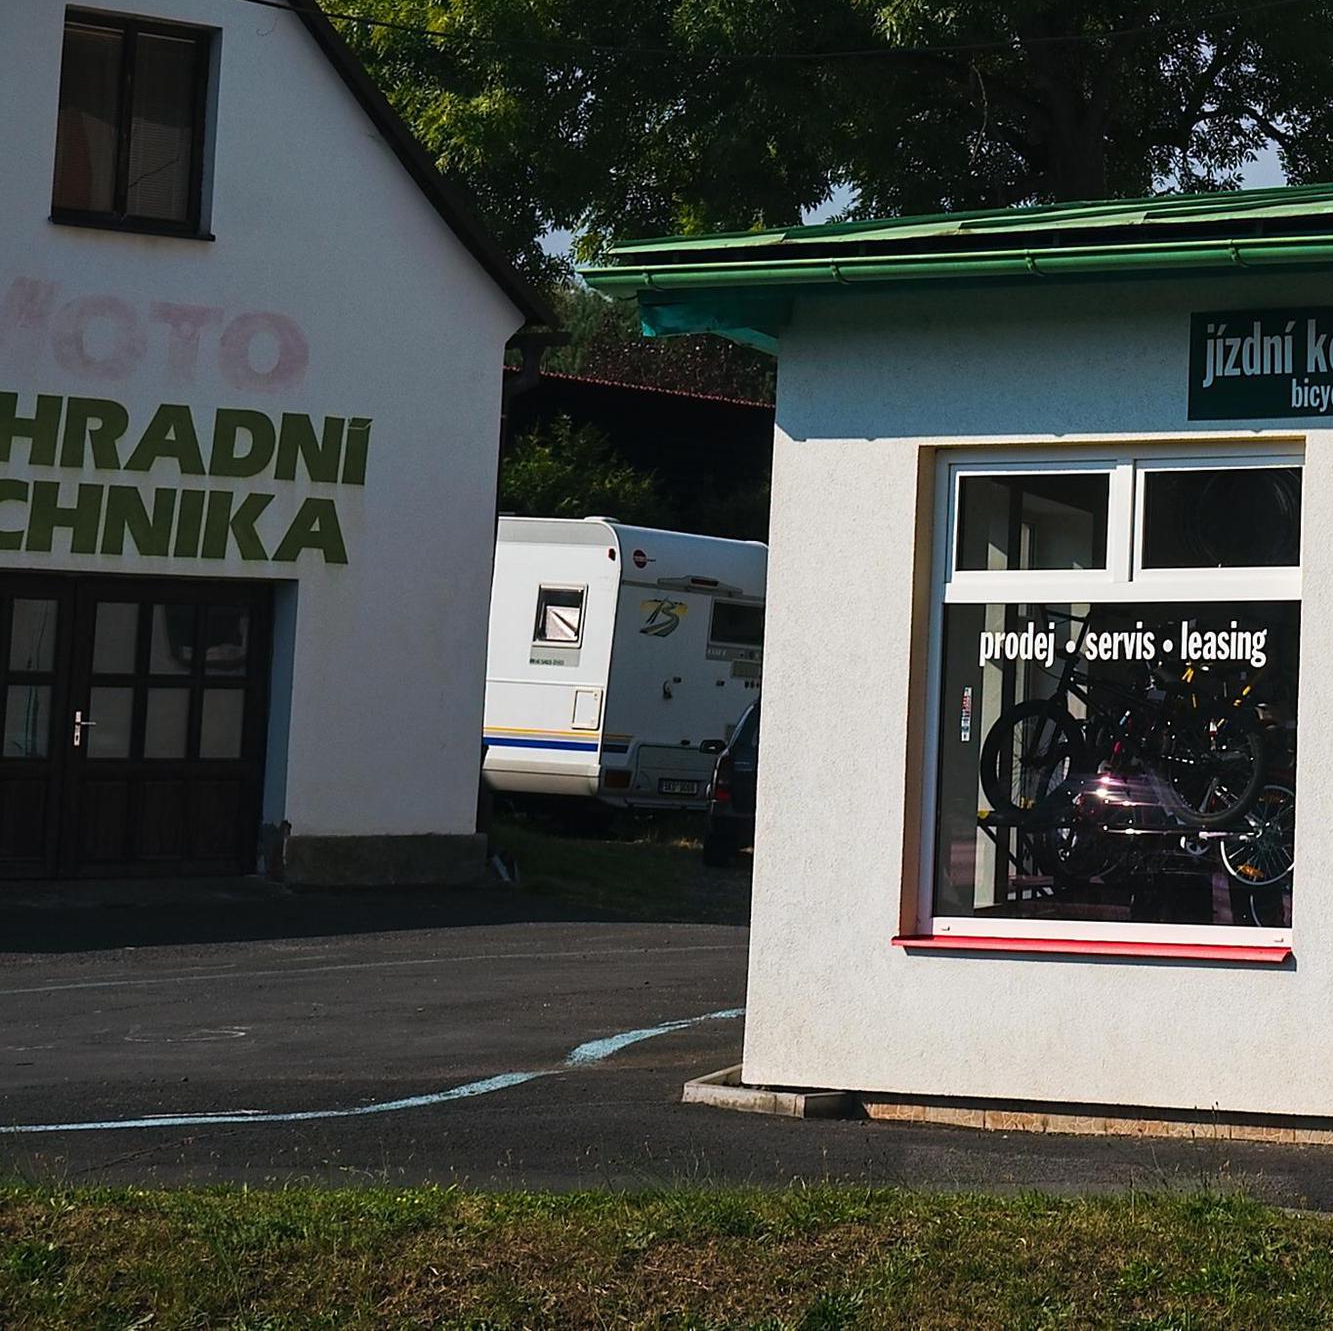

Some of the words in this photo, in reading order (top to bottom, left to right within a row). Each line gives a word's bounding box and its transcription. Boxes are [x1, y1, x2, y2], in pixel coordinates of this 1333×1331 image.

[1203, 320, 1297, 389] jízdní
[979, 621, 1055, 668] prodej
[1085, 620, 1156, 661] servis
[1180, 620, 1268, 668] leasing
